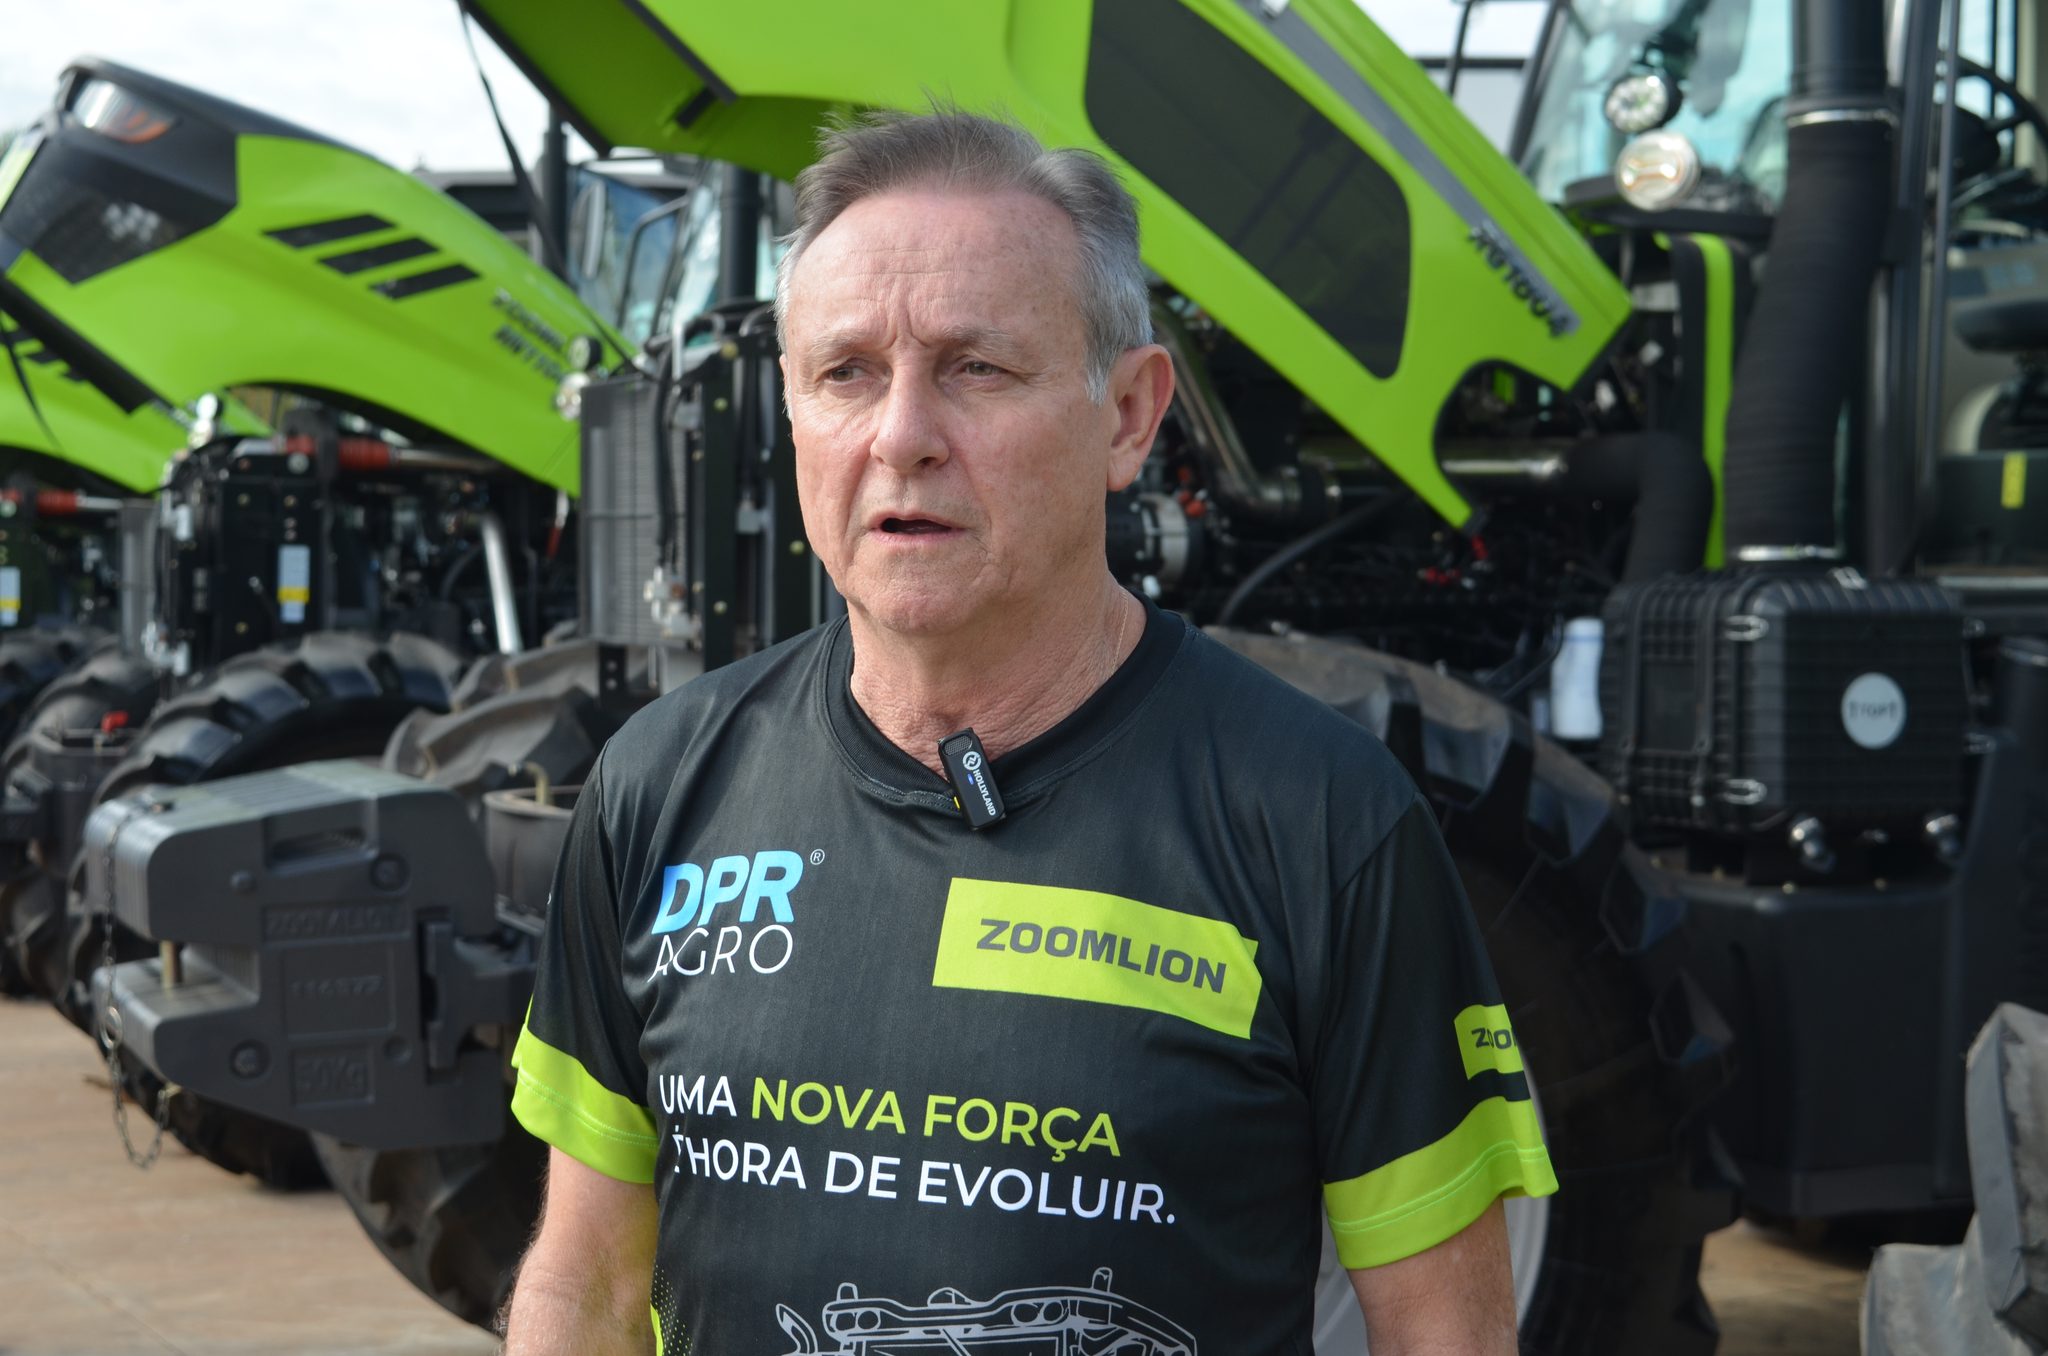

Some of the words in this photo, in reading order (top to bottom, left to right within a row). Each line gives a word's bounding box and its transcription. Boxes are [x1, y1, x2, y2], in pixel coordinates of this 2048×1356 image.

[972, 768, 997, 817] HOLLYLAND
[651, 850, 804, 935] DPR
[647, 924, 794, 983] AGRO
[976, 918, 1228, 994] ZOOMLION
[659, 1074, 738, 1118] UMA
[751, 1076, 906, 1135] NOVA
[922, 1094, 1121, 1163] FORÇA
[685, 1136, 808, 1190] HORA
[825, 1150, 901, 1200] DE
[917, 1159, 1177, 1225] EVOLUIR.
